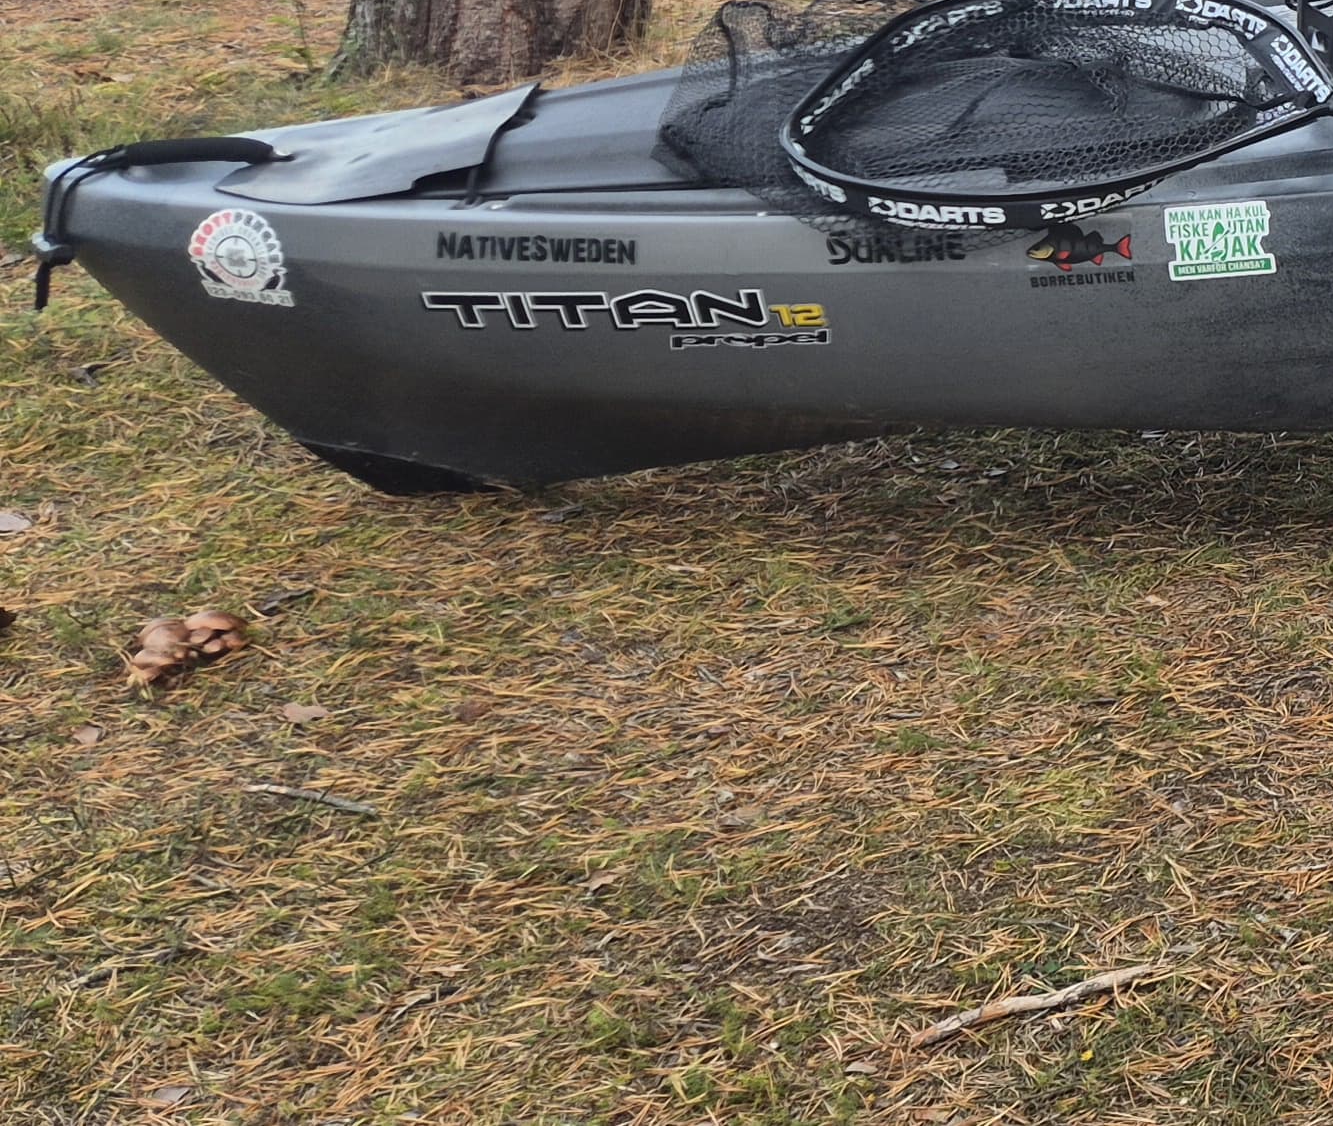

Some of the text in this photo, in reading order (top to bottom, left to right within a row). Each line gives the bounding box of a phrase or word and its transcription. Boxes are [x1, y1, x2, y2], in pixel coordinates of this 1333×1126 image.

[1283, 48, 1331, 103] DARTS
[896, 201, 1007, 224] DARTS
[1168, 205, 1267, 223] MAN KAN HA KUL
[1169, 217, 1265, 239] FISKE UTAN
[1180, 234, 1261, 262] KAJAK
[1029, 270, 1135, 289] BORREBUTIKEN
[421, 289, 828, 330] TITAN 12
[669, 328, 831, 349] propel
